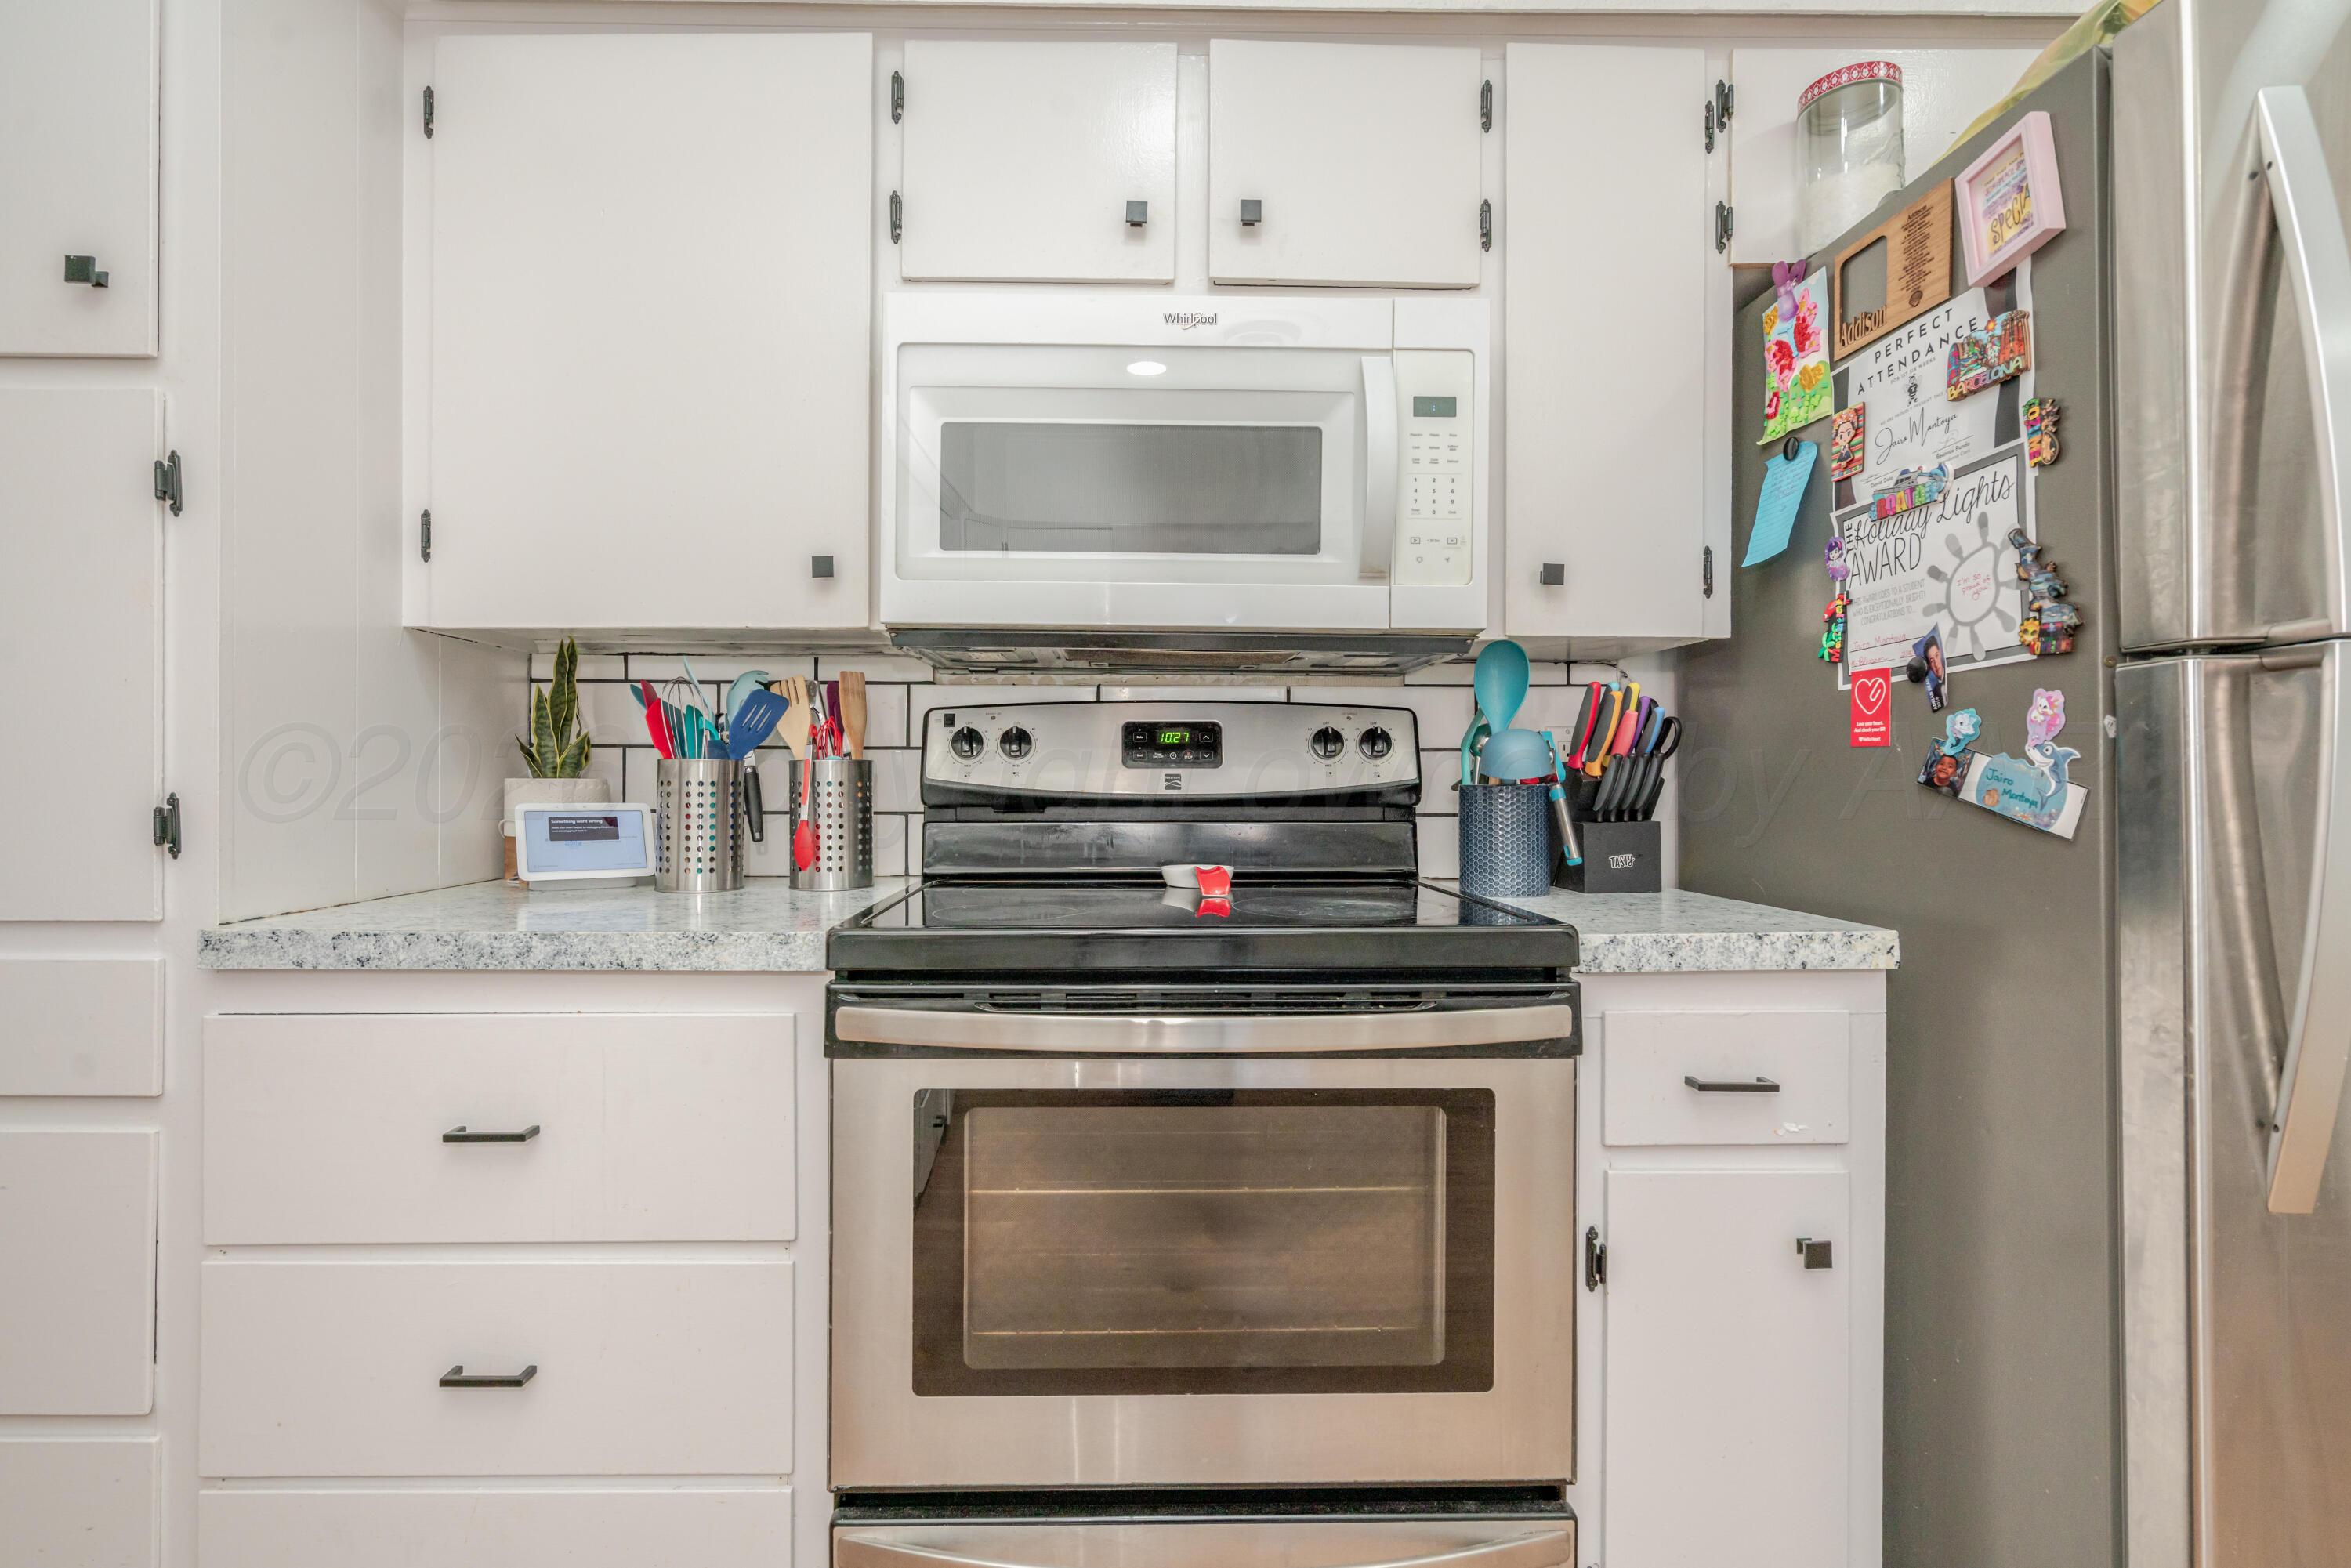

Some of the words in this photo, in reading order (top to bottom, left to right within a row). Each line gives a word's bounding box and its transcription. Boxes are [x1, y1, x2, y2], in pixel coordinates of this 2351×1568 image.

[1164, 313, 1217, 327] Whirlpool
[1840, 305, 1887, 348] Addison
[1875, 308, 1953, 364] PERFECT
[1857, 317, 1978, 395] ATTENDANCE
[1918, 357, 1936, 369] WEEKS
[1947, 355, 2023, 401] BARCELONA
[1875, 427, 1907, 465] Jairo
[1909, 407, 1957, 447] Montoya
[2024, 398, 2042, 468] COZUMEL
[1854, 505, 1933, 549] Holiday
[1936, 470, 2015, 524] Lights
[1845, 523, 1854, 554] THE
[1849, 532, 1922, 589] AWARD
[1985, 767, 2014, 786] Jairo
[1609, 853, 1636, 869] TASTY
